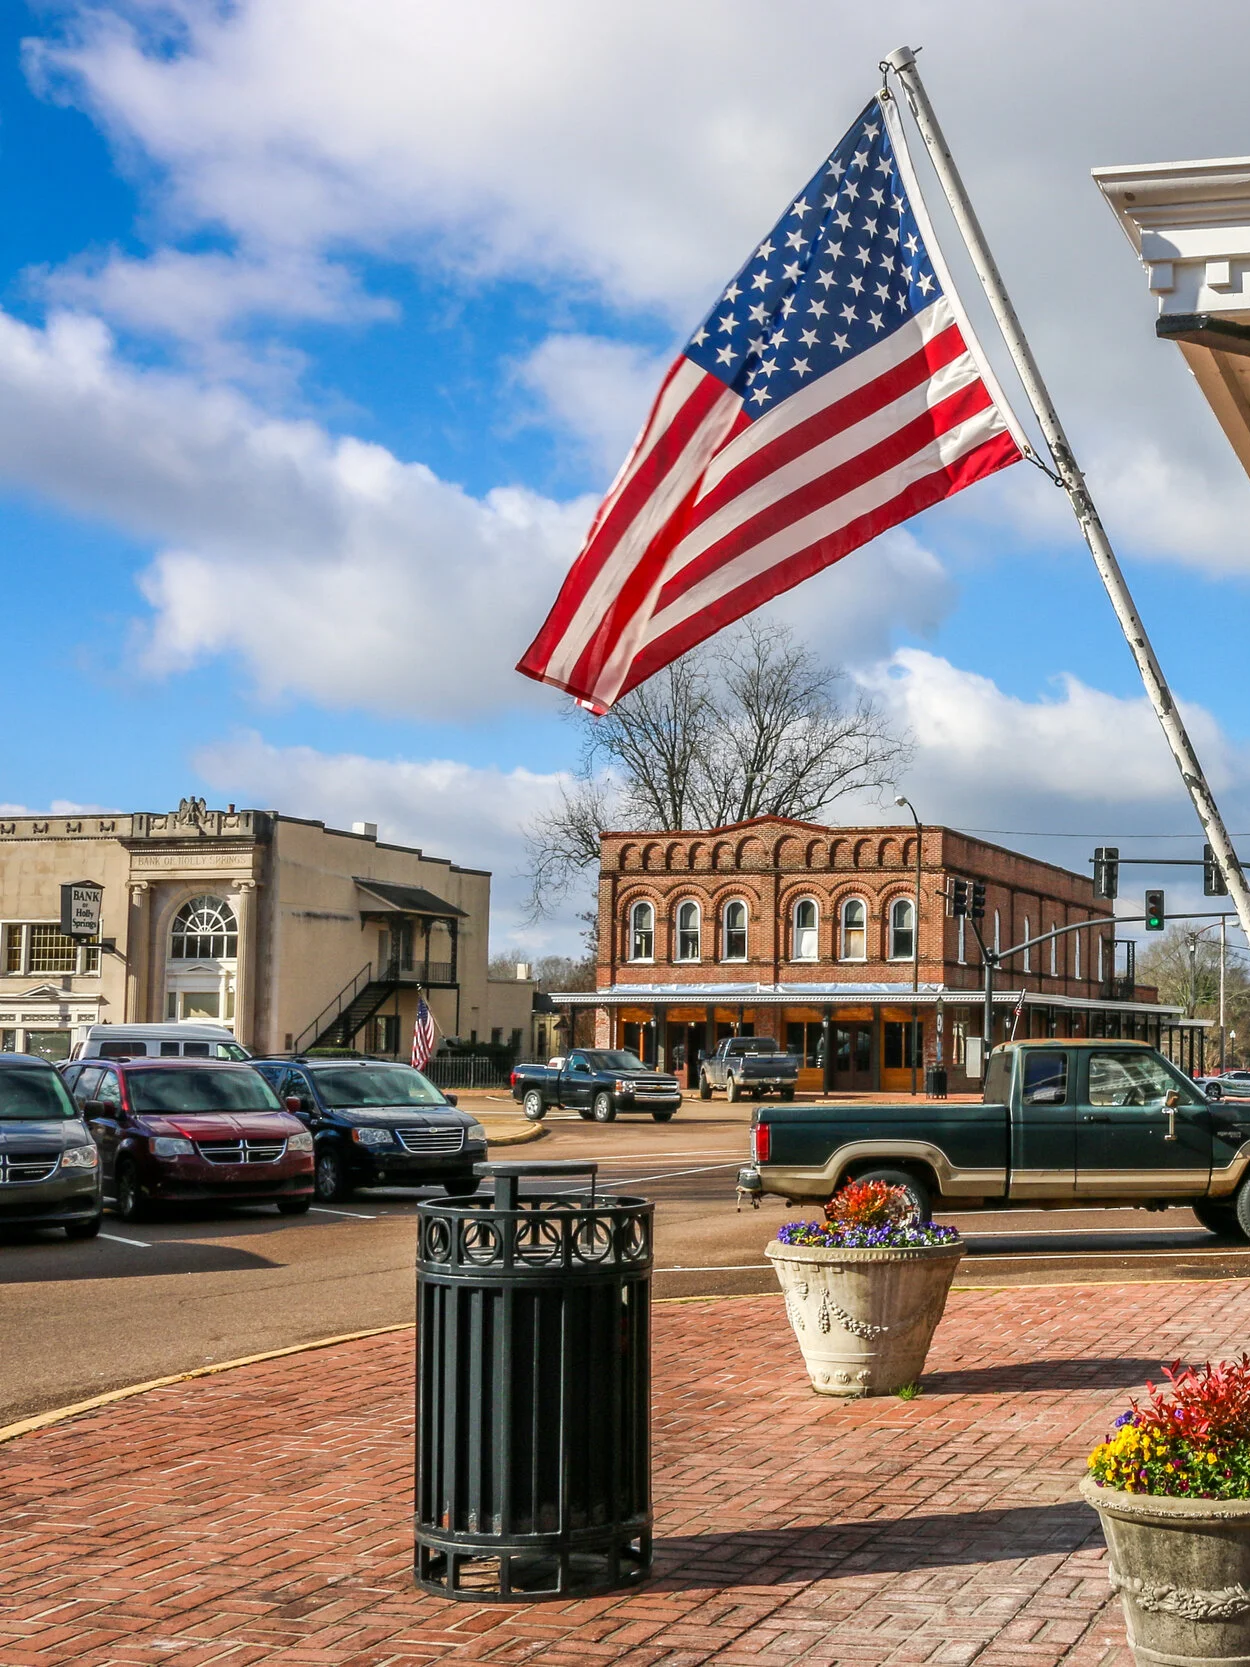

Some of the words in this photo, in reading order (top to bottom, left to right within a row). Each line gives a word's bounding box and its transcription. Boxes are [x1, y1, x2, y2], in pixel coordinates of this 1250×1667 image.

[138, 856, 160, 866] BANK
[164, 856, 174, 866] OF
[178, 855, 206, 865] HOLLY
[209, 854, 246, 865] SPRINGS
[73, 890, 100, 902] BANK
[76, 908, 94, 919] Holly
[72, 918, 97, 930] Springs
